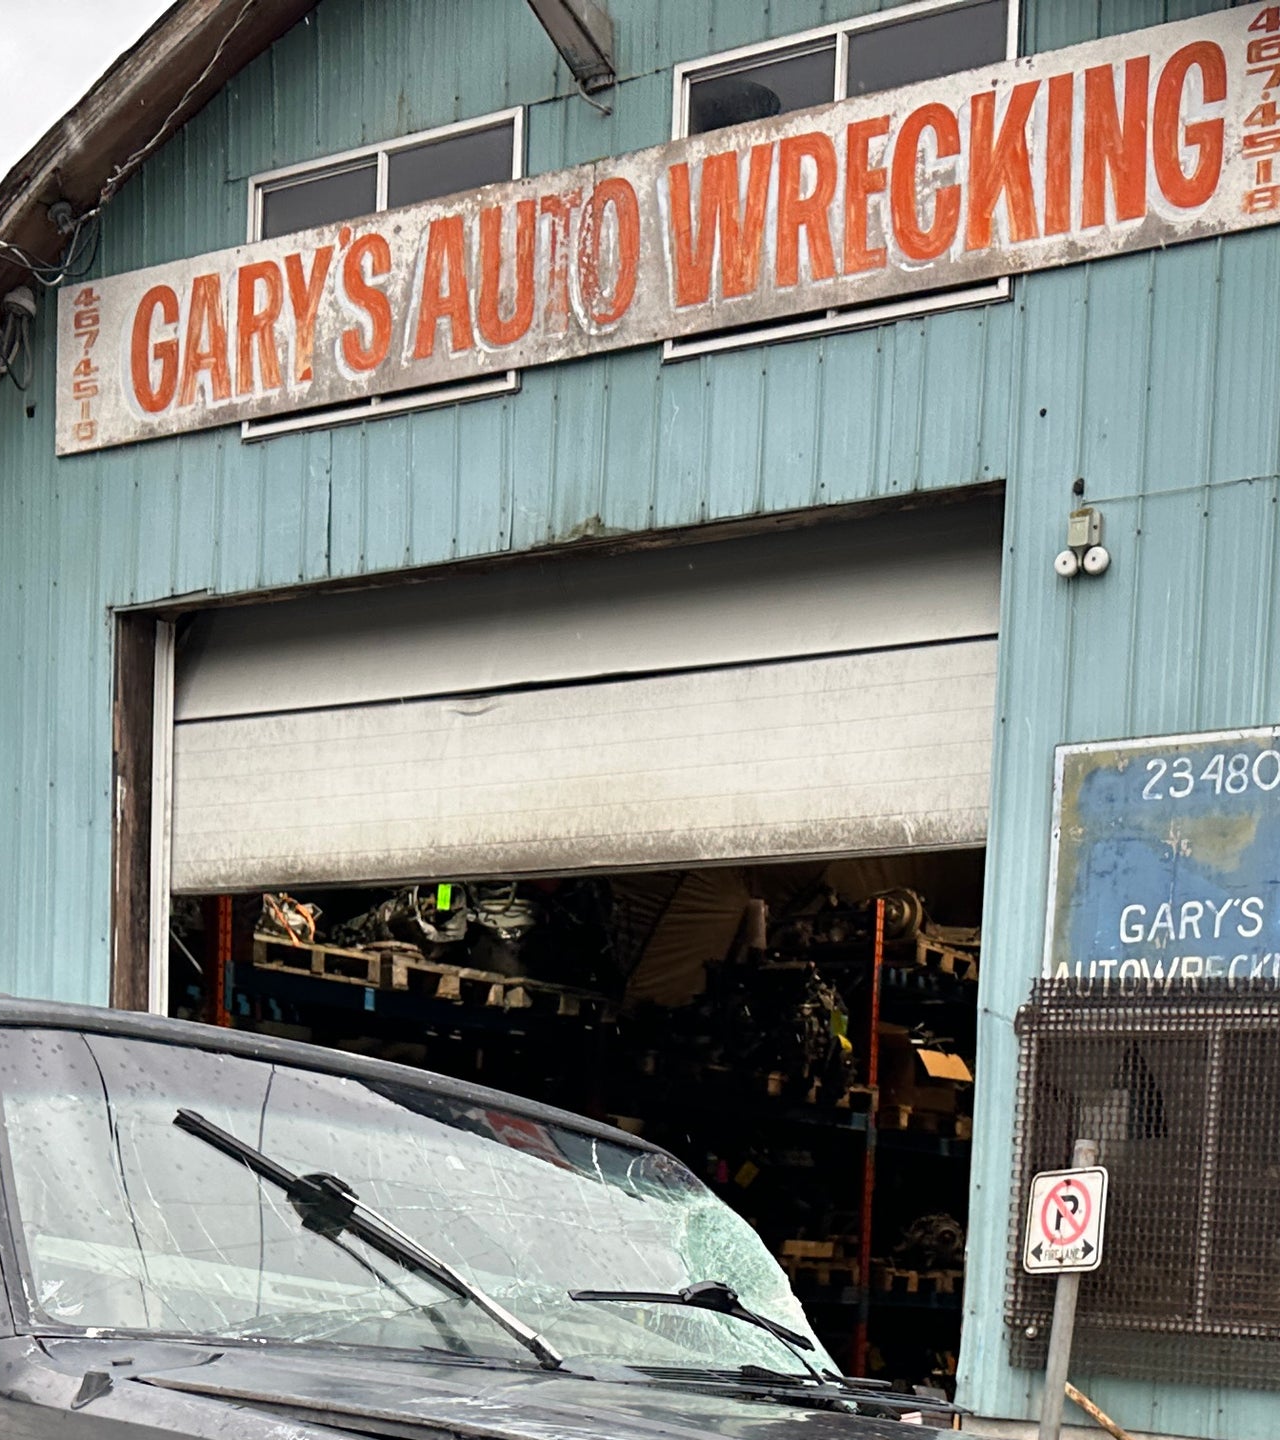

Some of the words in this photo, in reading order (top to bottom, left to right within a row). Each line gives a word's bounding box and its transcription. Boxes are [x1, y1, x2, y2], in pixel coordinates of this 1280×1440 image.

[130, 226, 392, 413] GARY'S
[412, 176, 640, 361] AUTO
[667, 40, 1228, 307] WRECKING
[1120, 897, 1264, 943] GARY'S
